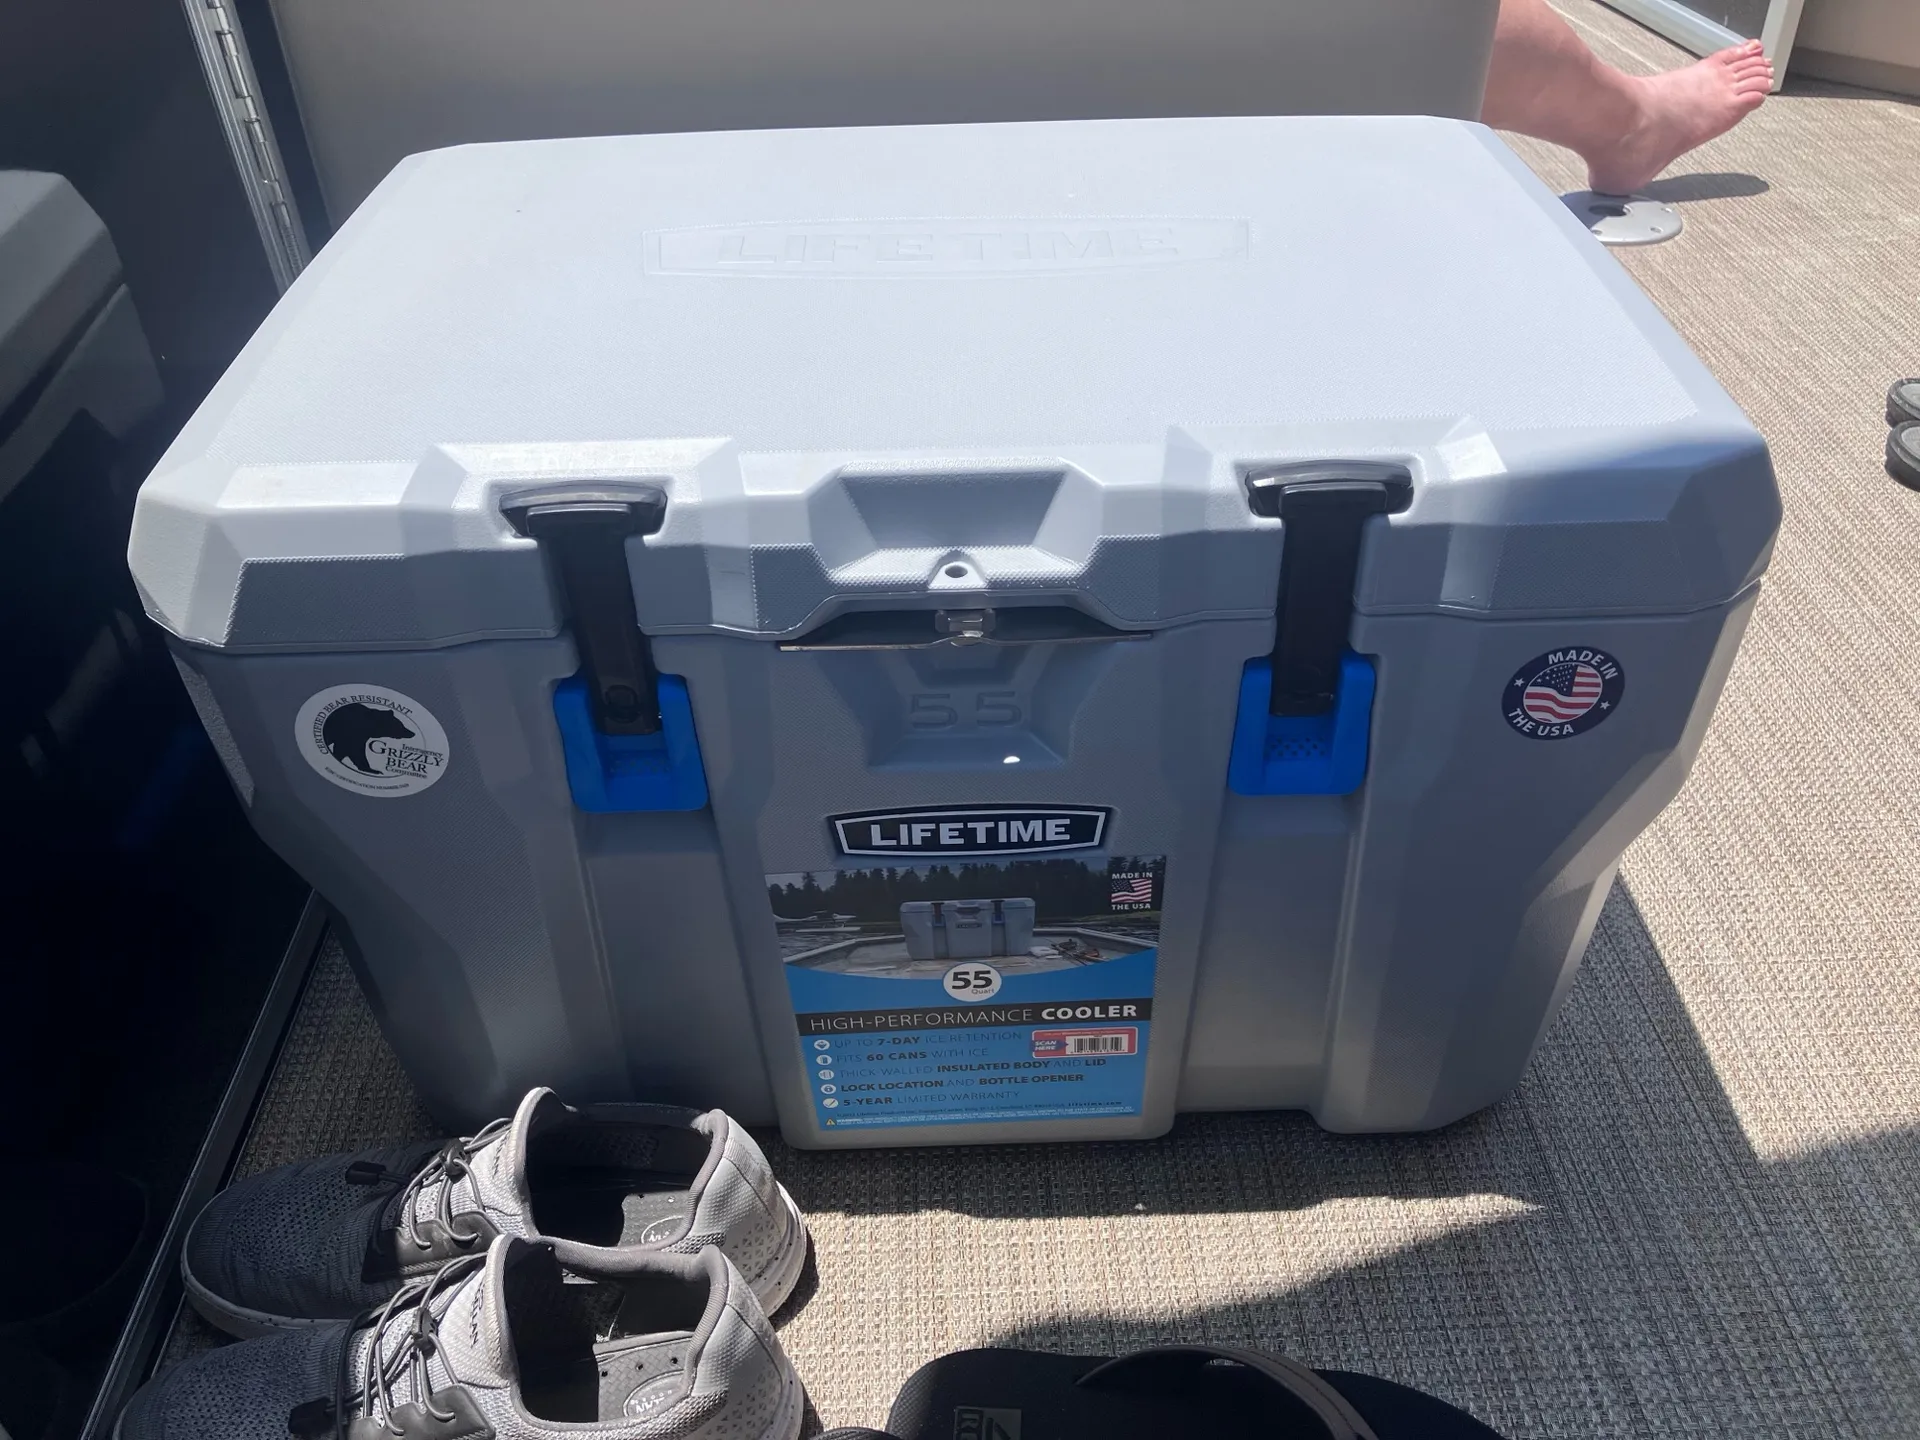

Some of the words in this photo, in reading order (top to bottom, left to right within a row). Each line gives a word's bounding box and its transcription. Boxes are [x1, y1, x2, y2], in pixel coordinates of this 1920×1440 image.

[715, 228, 1178, 264] LIFETIME
[1548, 650, 1605, 666] MADE
[1599, 662, 1619, 681] IN
[313, 711, 330, 755] CERTIFIED
[323, 697, 349, 713] BEAR
[350, 694, 413, 716] RESISTANT
[1508, 708, 1536, 733] THE
[1537, 724, 1575, 737] USA
[368, 739, 444, 767] GRIZZLY
[386, 757, 428, 774] BEAR
[870, 818, 1071, 846] LIFETIME
[1111, 872, 1140, 880] MADE
[952, 970, 993, 990] 55
[811, 1008, 1033, 1031] HIGH-PERFORMANCE
[1041, 1005, 1138, 1021] COOLER
[834, 1039, 851, 1049] UP
[857, 1038, 874, 1048] TO
[877, 1036, 921, 1046] 7-DAY
[925, 1034, 948, 1044] ICE
[950, 1031, 1022, 1042] RETENTION
[836, 1053, 862, 1064] FITS
[866, 1053, 884, 1062] 60
[889, 1051, 928, 1061] CANS
[931, 1049, 964, 1059] WITH
[969, 1048, 989, 1058] ICE
[937, 1061, 1011, 1073] INSULATED
[1013, 1060, 1051, 1070] BODY
[1053, 1059, 1082, 1068] AND
[1084, 1058, 1107, 1067] LID
[841, 1083, 876, 1093] LOCK
[878, 1080, 944, 1091] LOCATION
[947, 1078, 975, 1087] AND
[979, 1076, 1029, 1085] BOTTLE
[1031, 1074, 1085, 1083] OPENER
[843, 1097, 893, 1107] 5-YEAR
[897, 1094, 947, 1104] LIMITED
[950, 1091, 1021, 1101] WARRANTY
